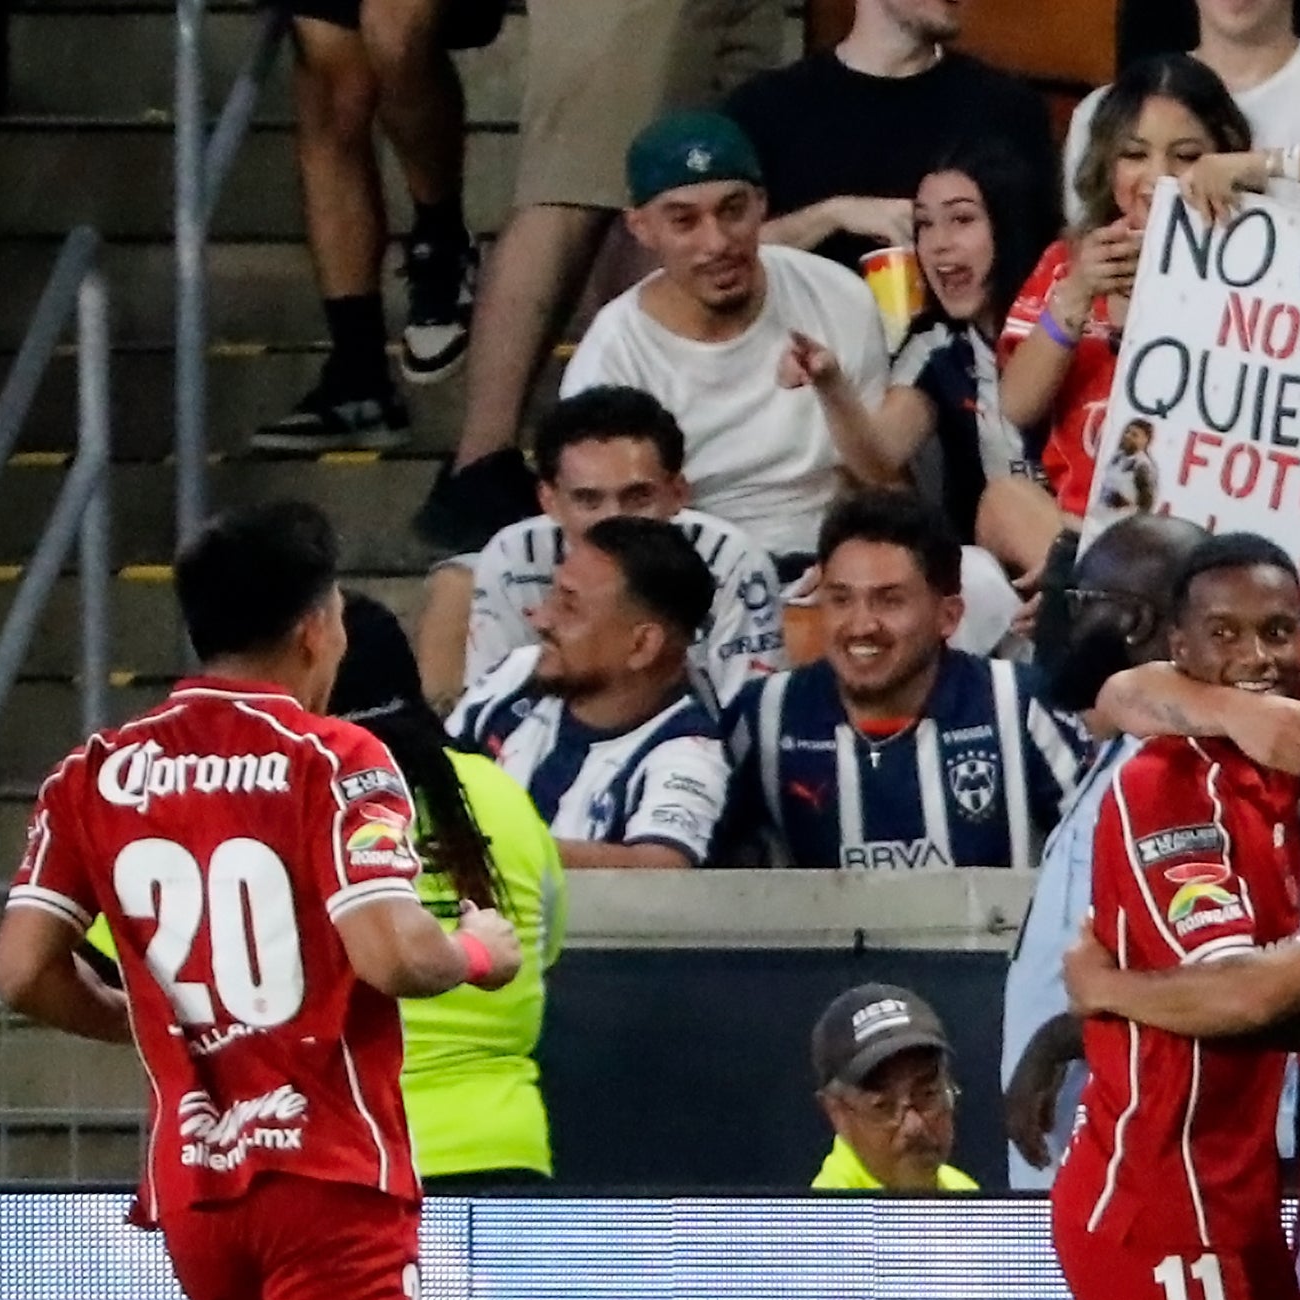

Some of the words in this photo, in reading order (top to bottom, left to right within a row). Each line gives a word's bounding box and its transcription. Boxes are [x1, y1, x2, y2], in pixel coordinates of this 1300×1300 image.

[1159, 194, 1277, 288] NO
[99, 738, 291, 813] Corona
[113, 837, 305, 1028] 20
